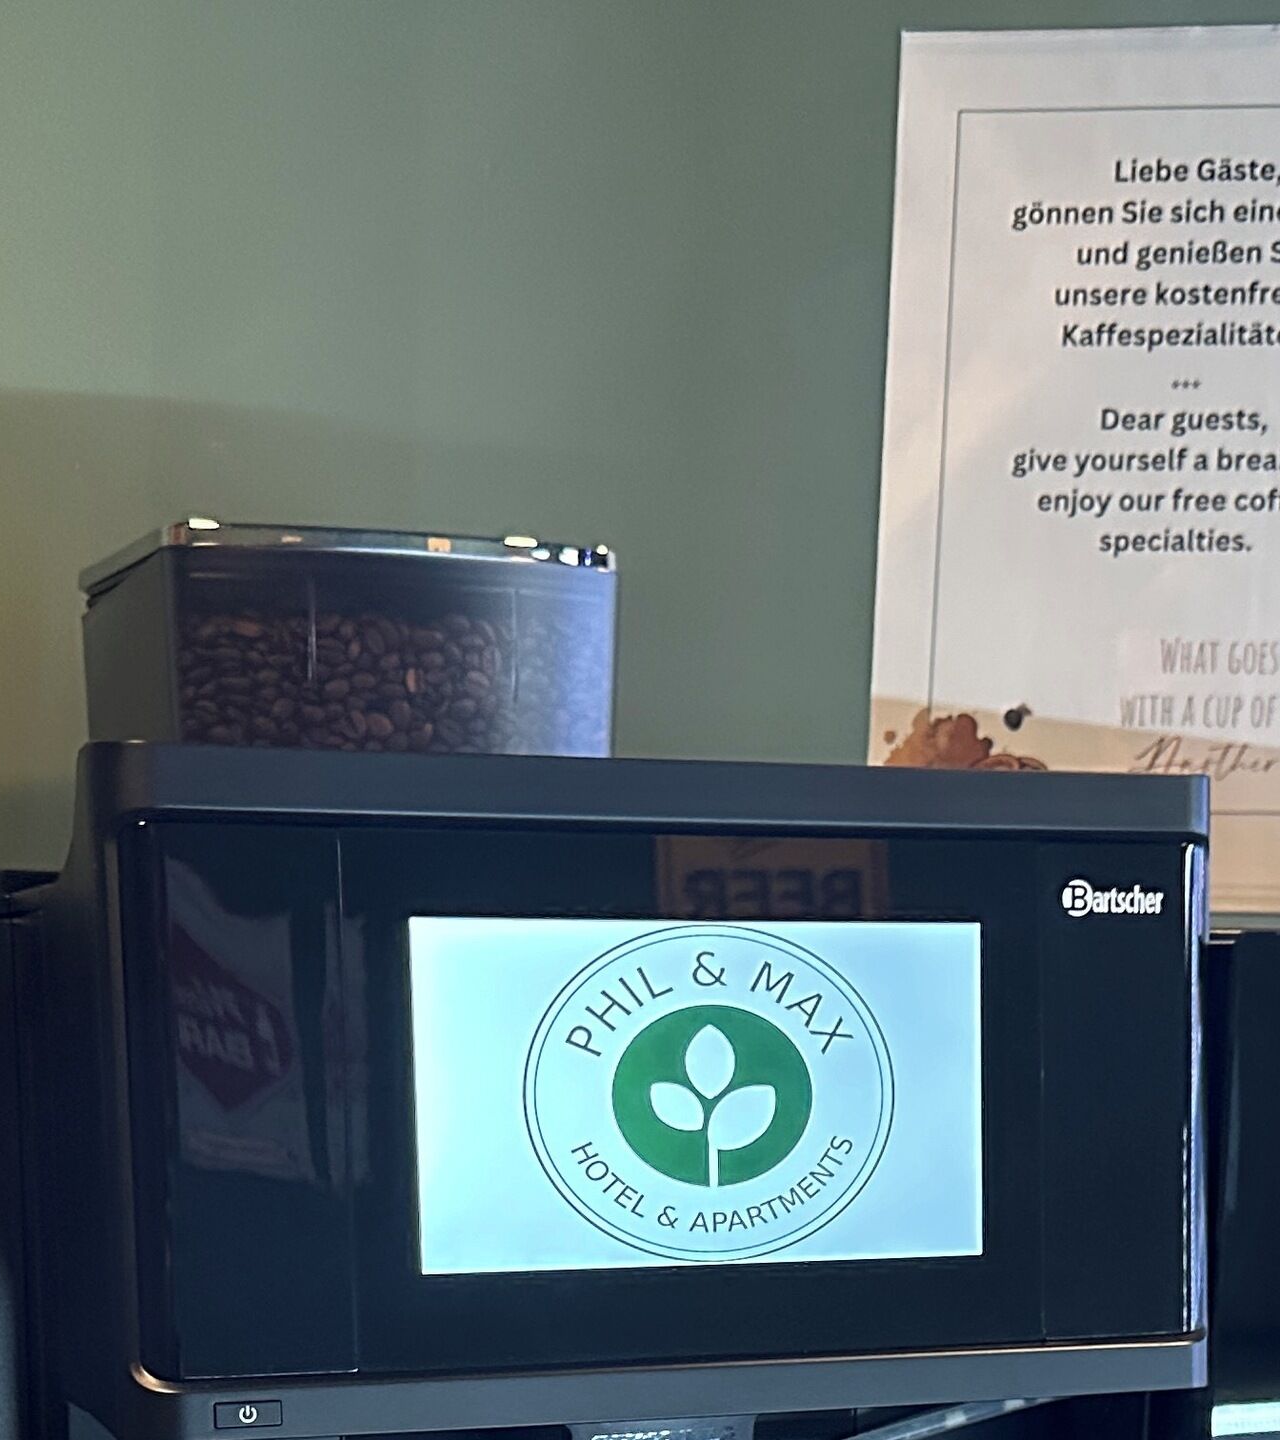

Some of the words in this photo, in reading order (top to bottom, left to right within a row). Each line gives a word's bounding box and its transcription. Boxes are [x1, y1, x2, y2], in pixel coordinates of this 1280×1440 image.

[1114, 158, 1189, 184] Liebe
[1011, 201, 1115, 232] gönnen
[1121, 198, 1164, 225] Sie
[1169, 198, 1226, 224] sich
[1076, 240, 1130, 267] und
[1135, 239, 1263, 272] genießen
[1054, 284, 1148, 308] unsere
[1100, 406, 1166, 433] Dear
[1170, 409, 1269, 437] guests,
[1011, 447, 1068, 478] give
[1073, 447, 1189, 478] yourself
[1192, 453, 1210, 474] a
[1036, 488, 1113, 519] enjoy
[1117, 492, 1167, 514] our
[1172, 487, 1228, 514] free
[1098, 528, 1253, 560] specialties.
[1227, 640, 1280, 677] GOES
[1181, 694, 1196, 728] A
[1202, 694, 1245, 730] CUP
[1249, 694, 1278, 730] OF
[1062, 878, 1164, 918] Bartscher
[565, 966, 674, 1057] PHIL
[691, 951, 728, 987] &
[749, 960, 855, 1056] MAX
[570, 1141, 646, 1219] HOTEL
[656, 1205, 680, 1229] &
[688, 1134, 854, 1233] APARTMENTS
